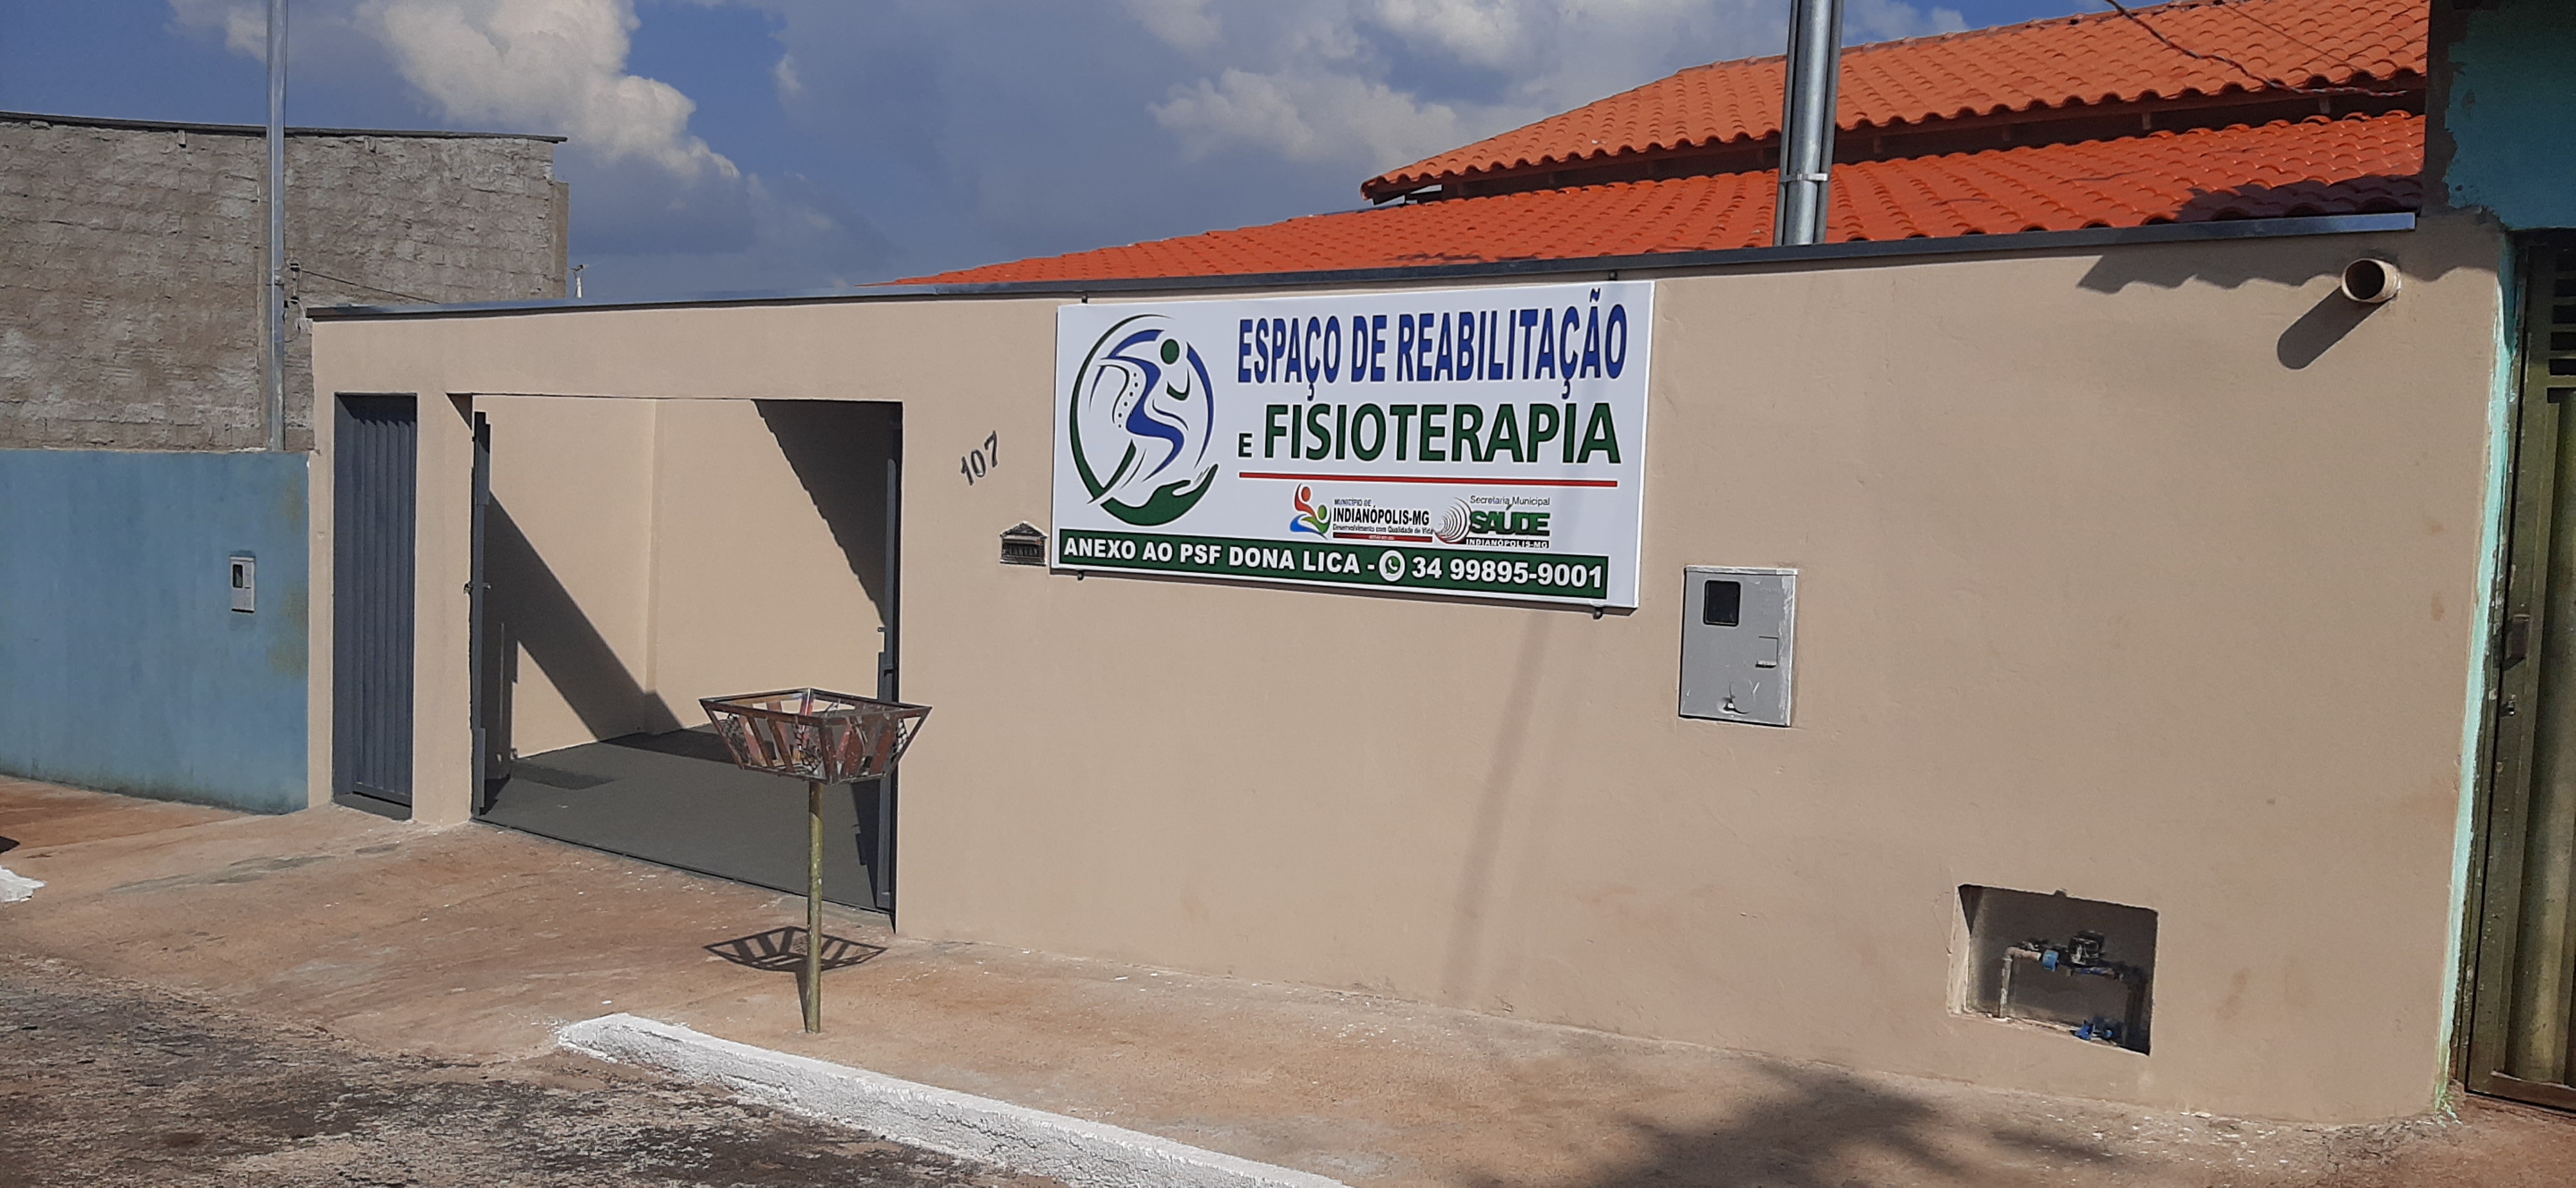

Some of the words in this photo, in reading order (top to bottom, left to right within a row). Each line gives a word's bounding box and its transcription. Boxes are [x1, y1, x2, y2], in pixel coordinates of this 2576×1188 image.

[1237, 315, 1341, 402] ESPAÇO
[1351, 314, 1387, 383] DE
[1397, 287, 1628, 400] REABILITAÇÃO
[1238, 432, 1253, 458] E
[1264, 403, 1622, 464] FISIOTERAPIA
[960, 430, 998, 486] 107
[1333, 505, 1430, 526] INDIANÓPOLIS-MG
[1470, 495, 1510, 505] Secretaria
[1513, 497, 1550, 507] Municipal
[1470, 504, 1551, 536] SAÚDE
[1063, 537, 1136, 560] ANEXO
[1142, 541, 1173, 562] AO
[1180, 543, 1222, 565] PSF
[1229, 546, 1295, 570] DONA
[1303, 550, 1360, 574] LICA
[1412, 556, 1443, 579] 34
[1450, 558, 1603, 588] 99895-9001
[1466, 538, 1548, 548] INDIANÓPOLIS-MG
